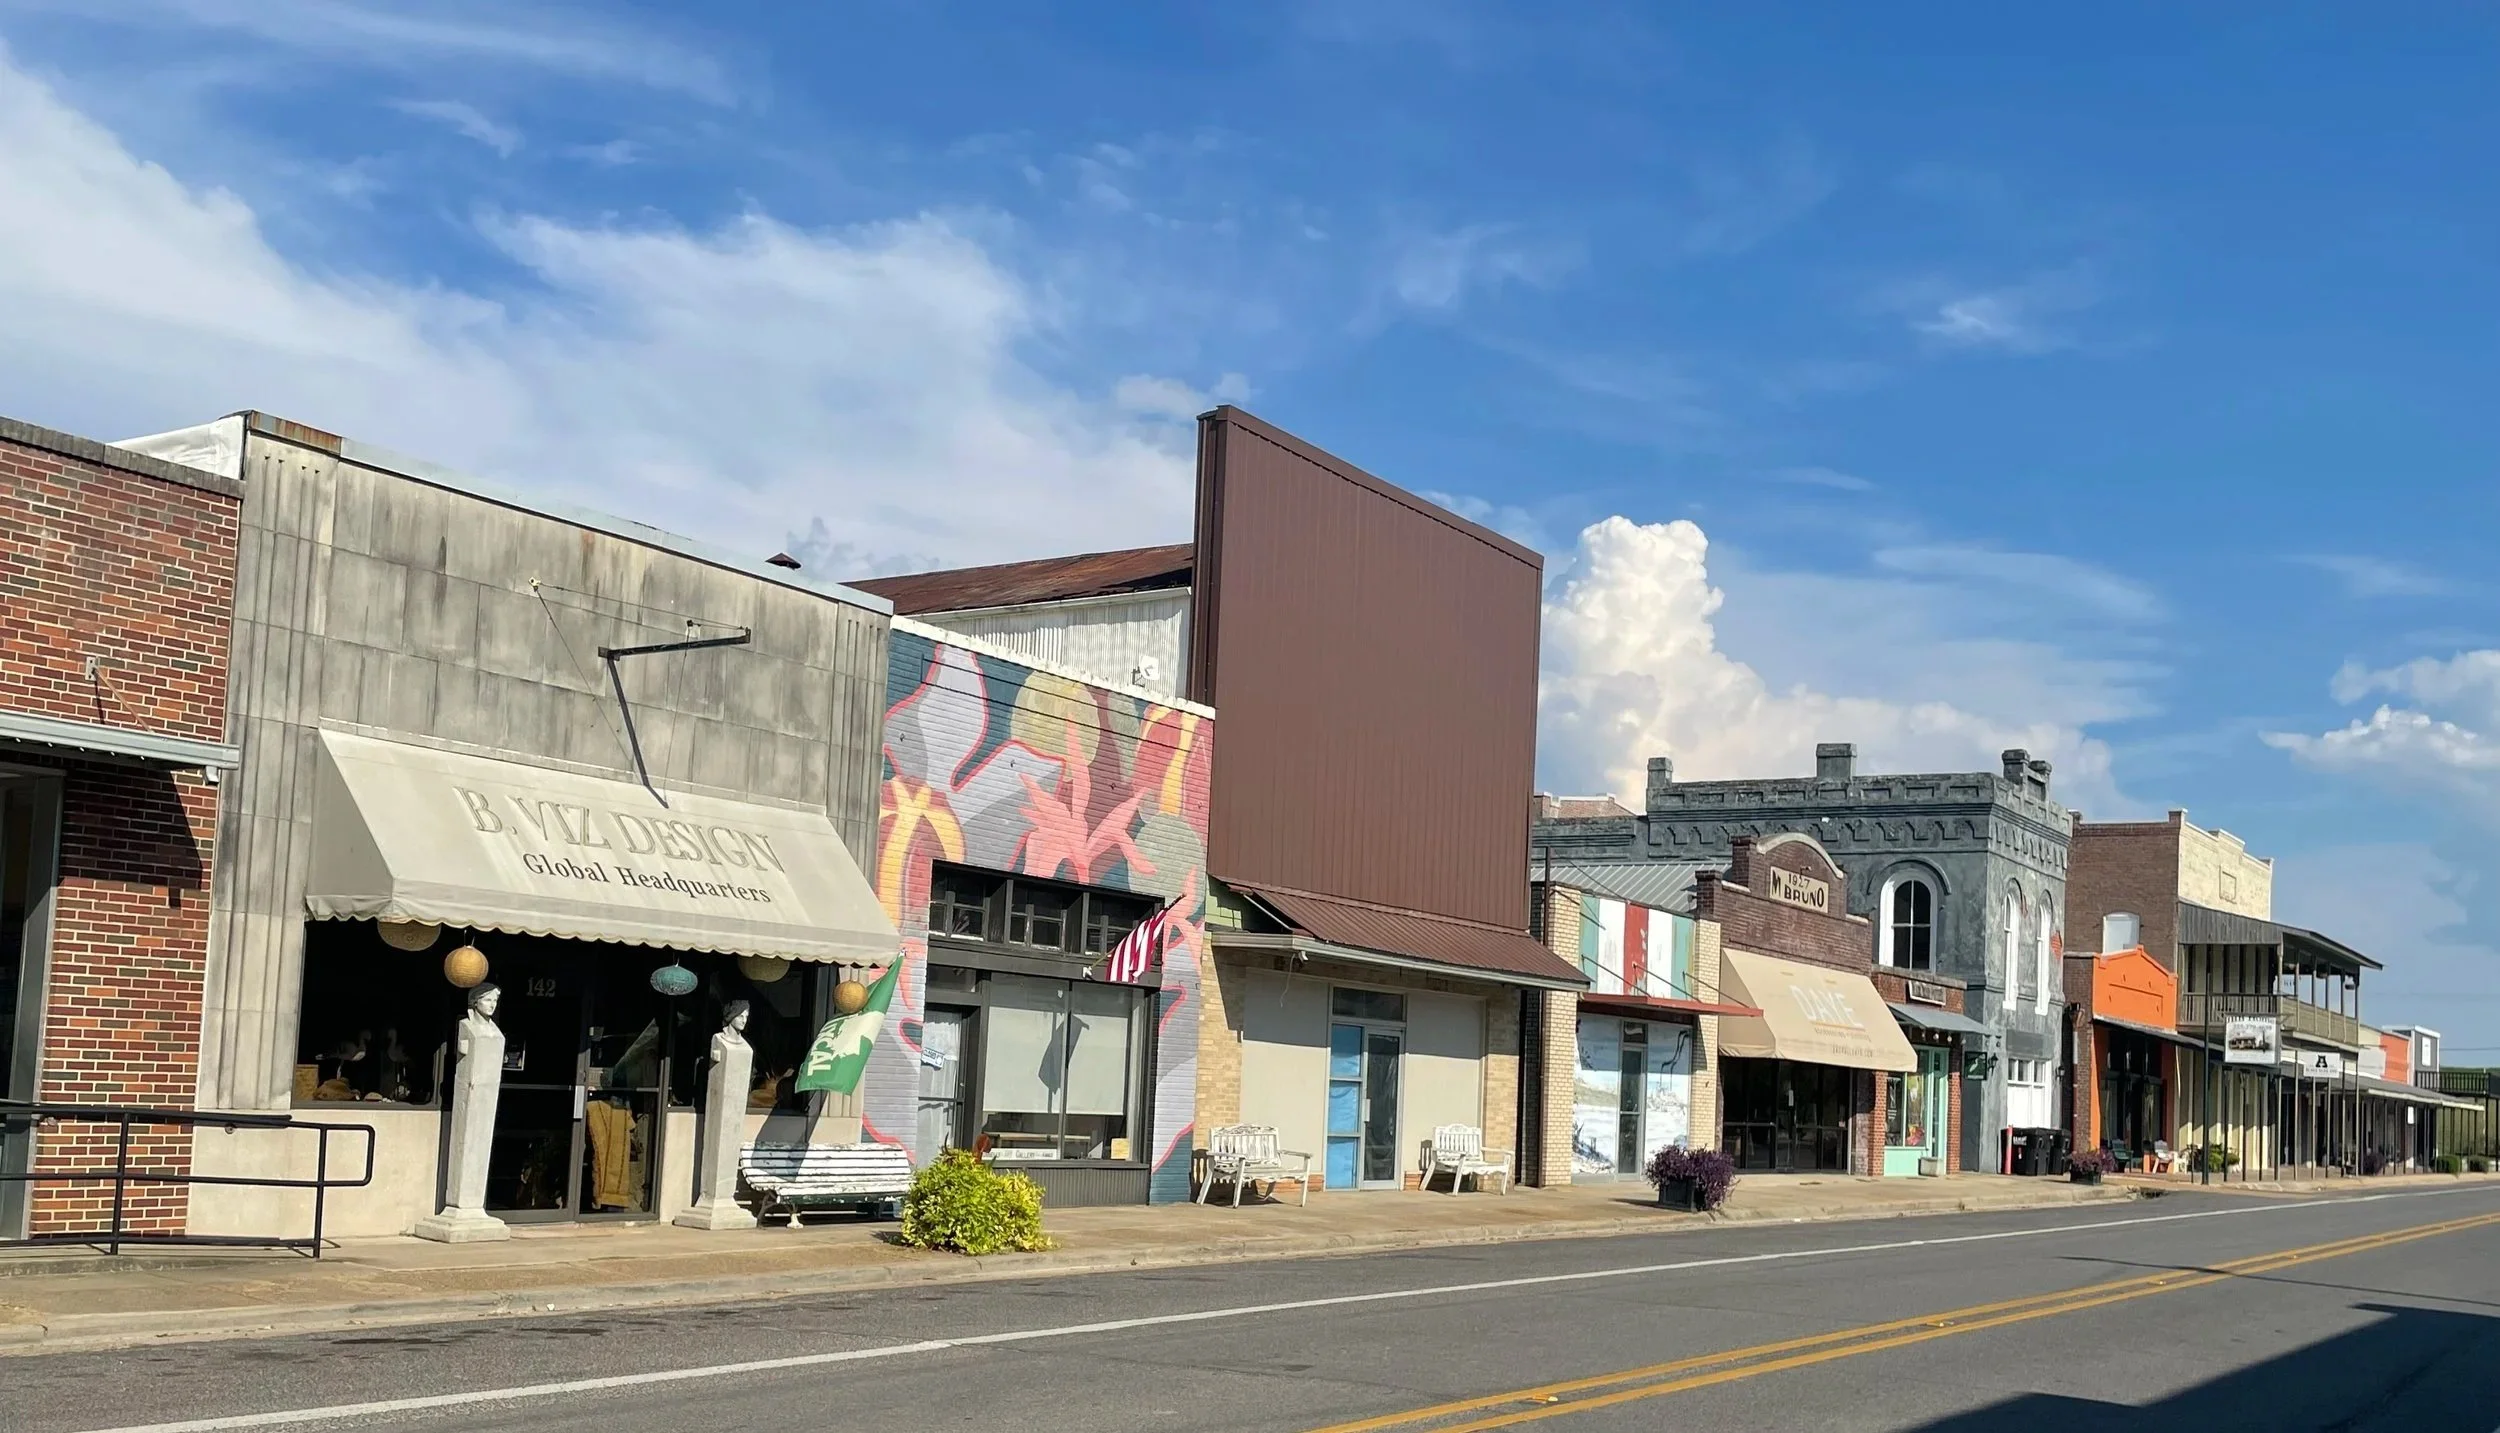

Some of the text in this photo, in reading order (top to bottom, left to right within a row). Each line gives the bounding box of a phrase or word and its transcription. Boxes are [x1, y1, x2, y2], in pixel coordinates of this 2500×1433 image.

[453, 786, 785, 874] B. VIZ DESIGN
[522, 852, 771, 904] Global Headquarters
[1788, 873, 1811, 889] 1927
[1784, 884, 1825, 908] BRUNO
[526, 977, 556, 997] 142
